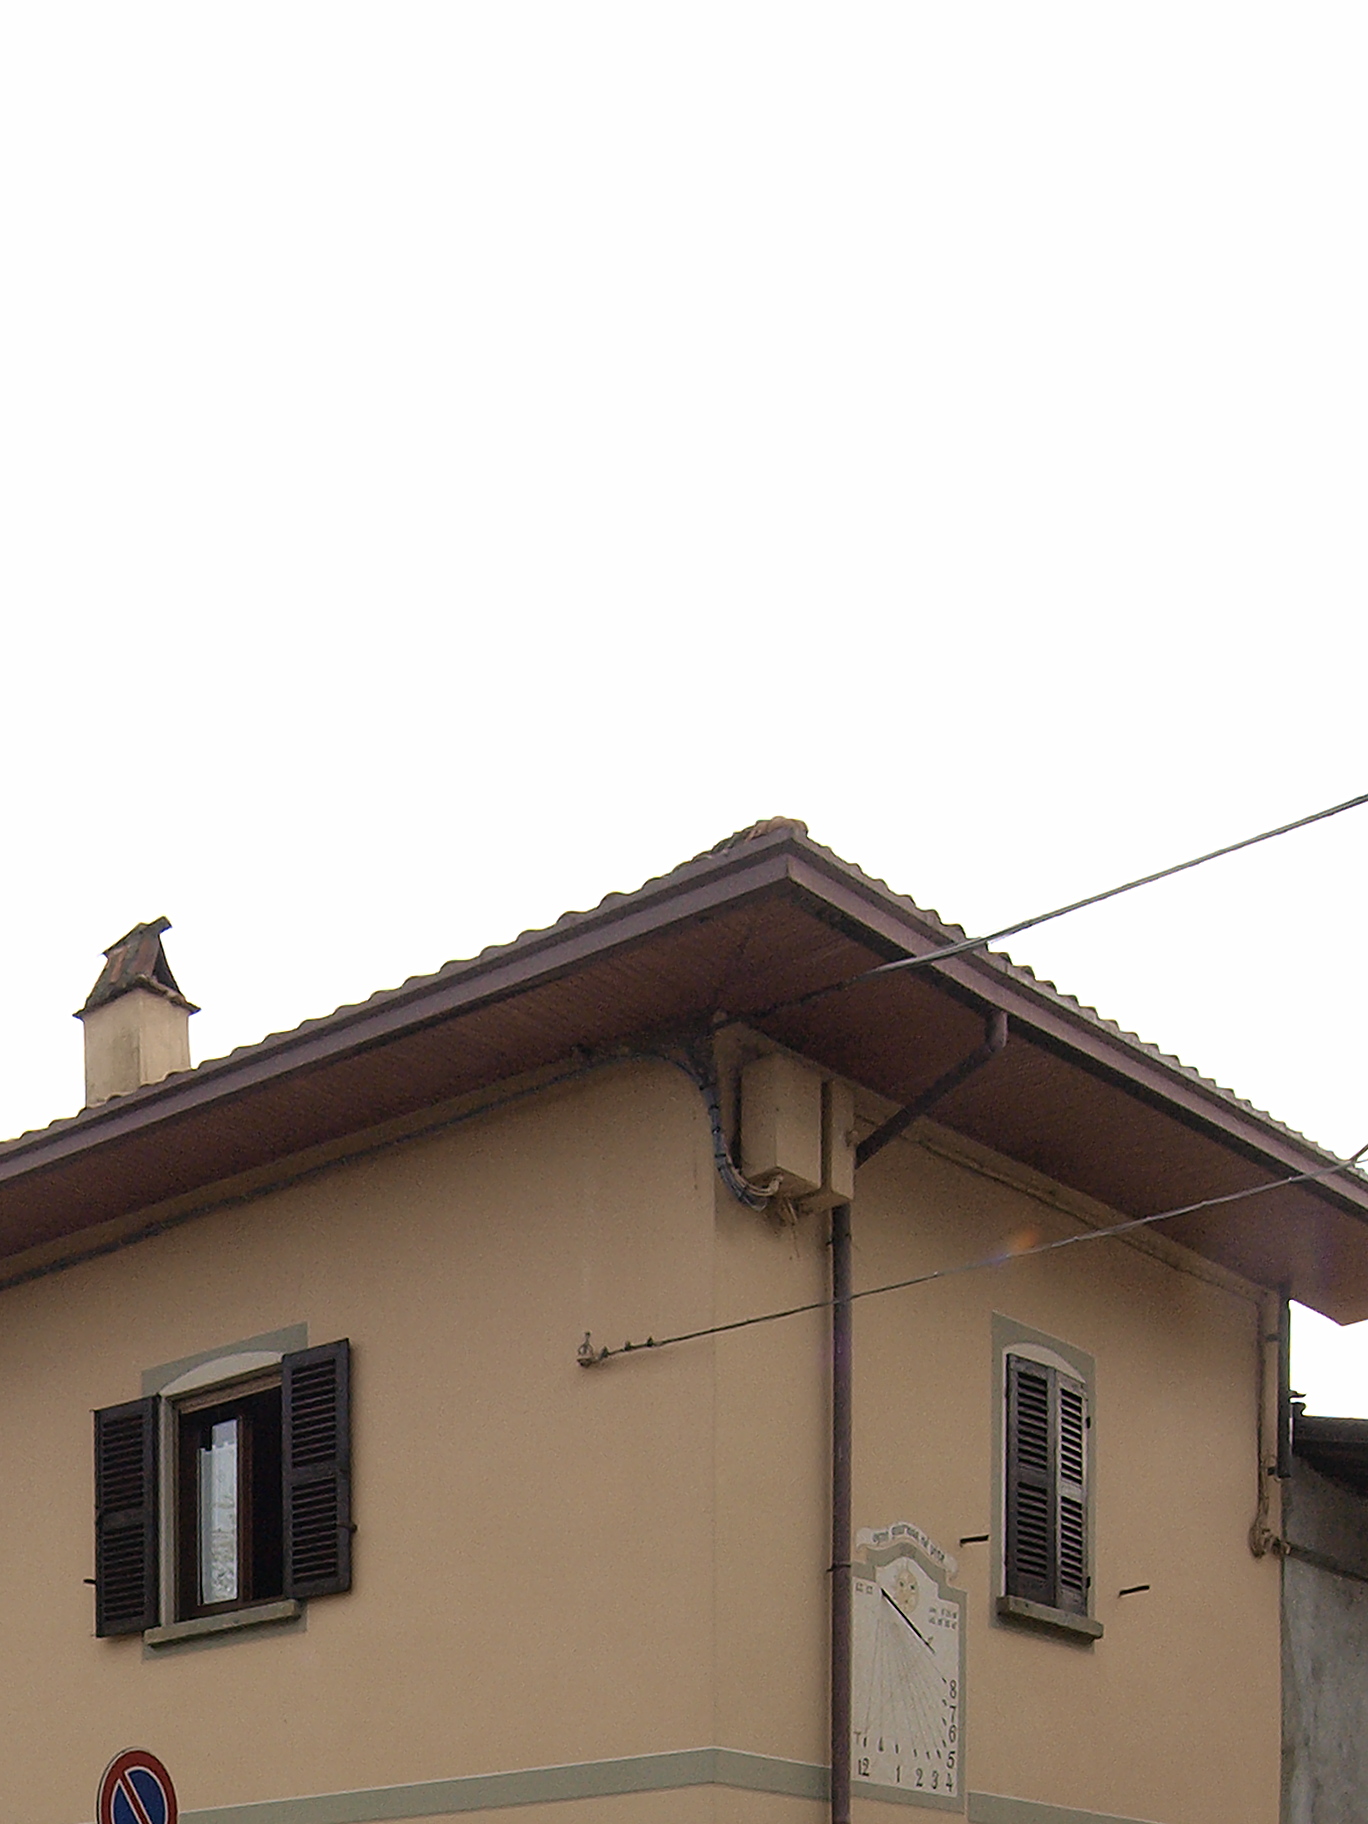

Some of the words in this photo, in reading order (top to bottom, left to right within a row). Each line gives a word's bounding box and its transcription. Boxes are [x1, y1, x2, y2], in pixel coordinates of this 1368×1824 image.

[949, 1679, 957, 1699] 8
[949, 1705, 957, 1723] 7
[948, 1724, 957, 1743] 6
[858, 1757, 870, 1777] 12
[946, 1751, 956, 1769] 5
[915, 1768, 924, 1787] 2
[931, 1770, 940, 1790] 3
[945, 1773, 953, 1792] 4
